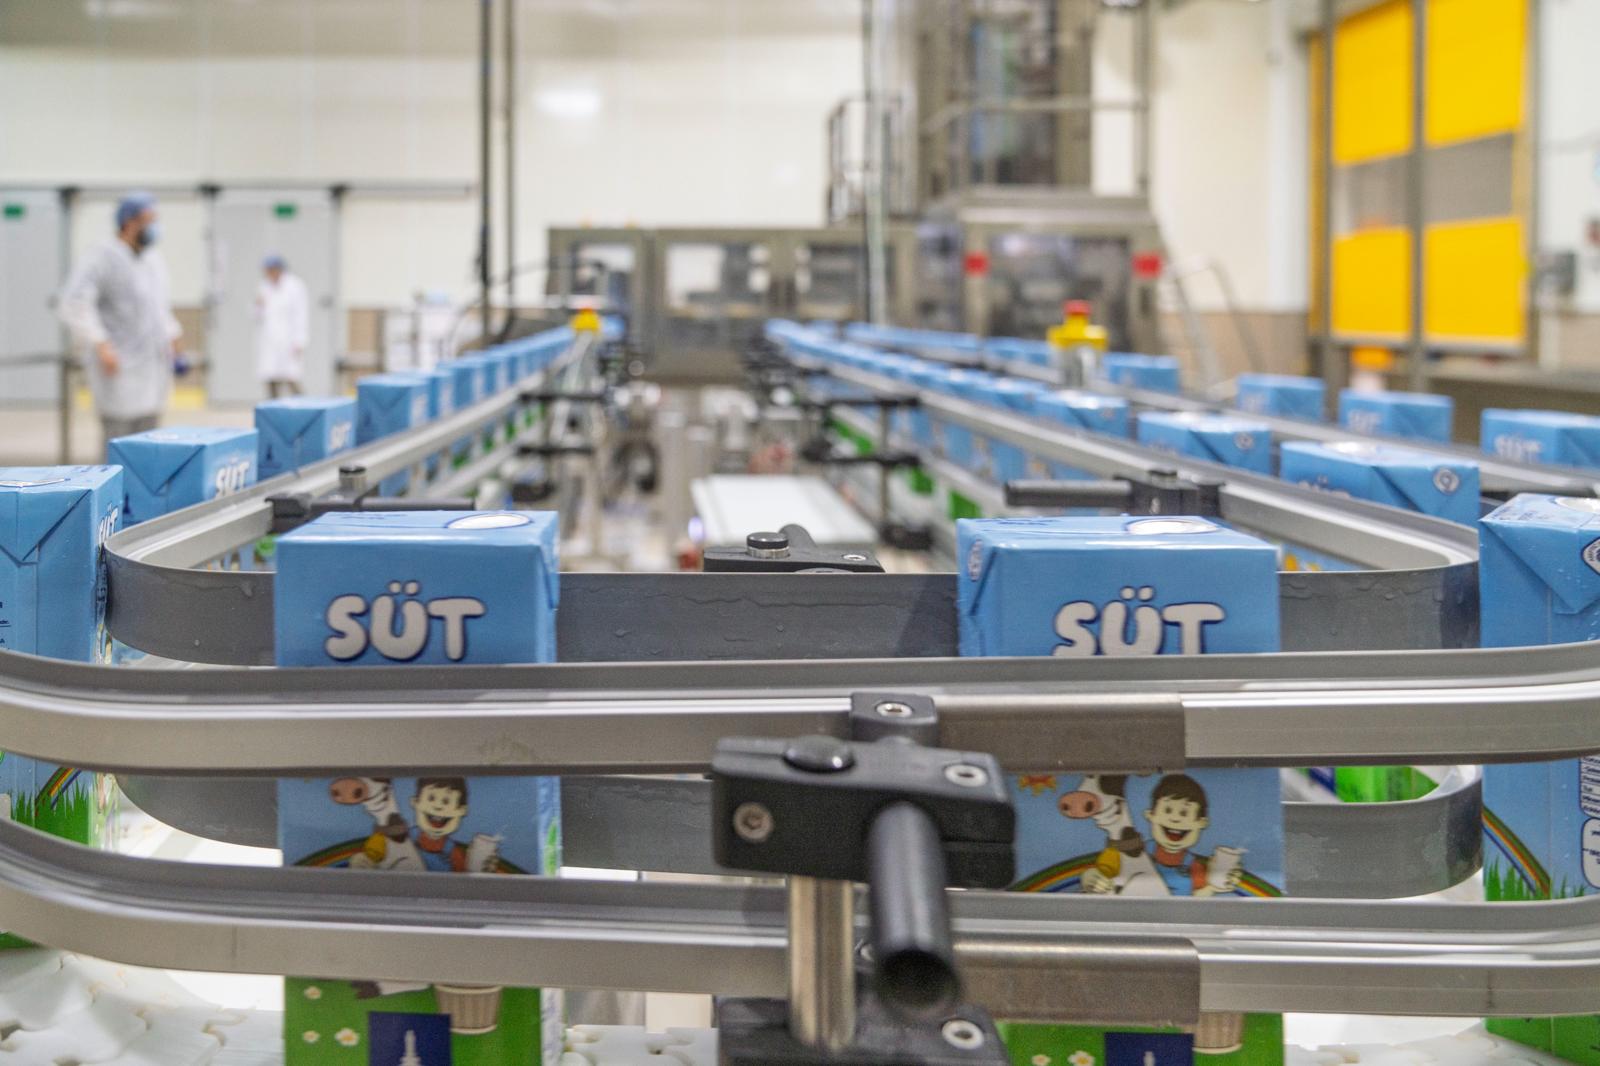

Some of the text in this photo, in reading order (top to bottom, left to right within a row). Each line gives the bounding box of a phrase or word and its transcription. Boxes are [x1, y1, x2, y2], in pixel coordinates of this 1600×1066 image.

[215, 456, 250, 496] SÜT
[325, 580, 486, 662] SÜT
[1053, 586, 1225, 656] SÜT
